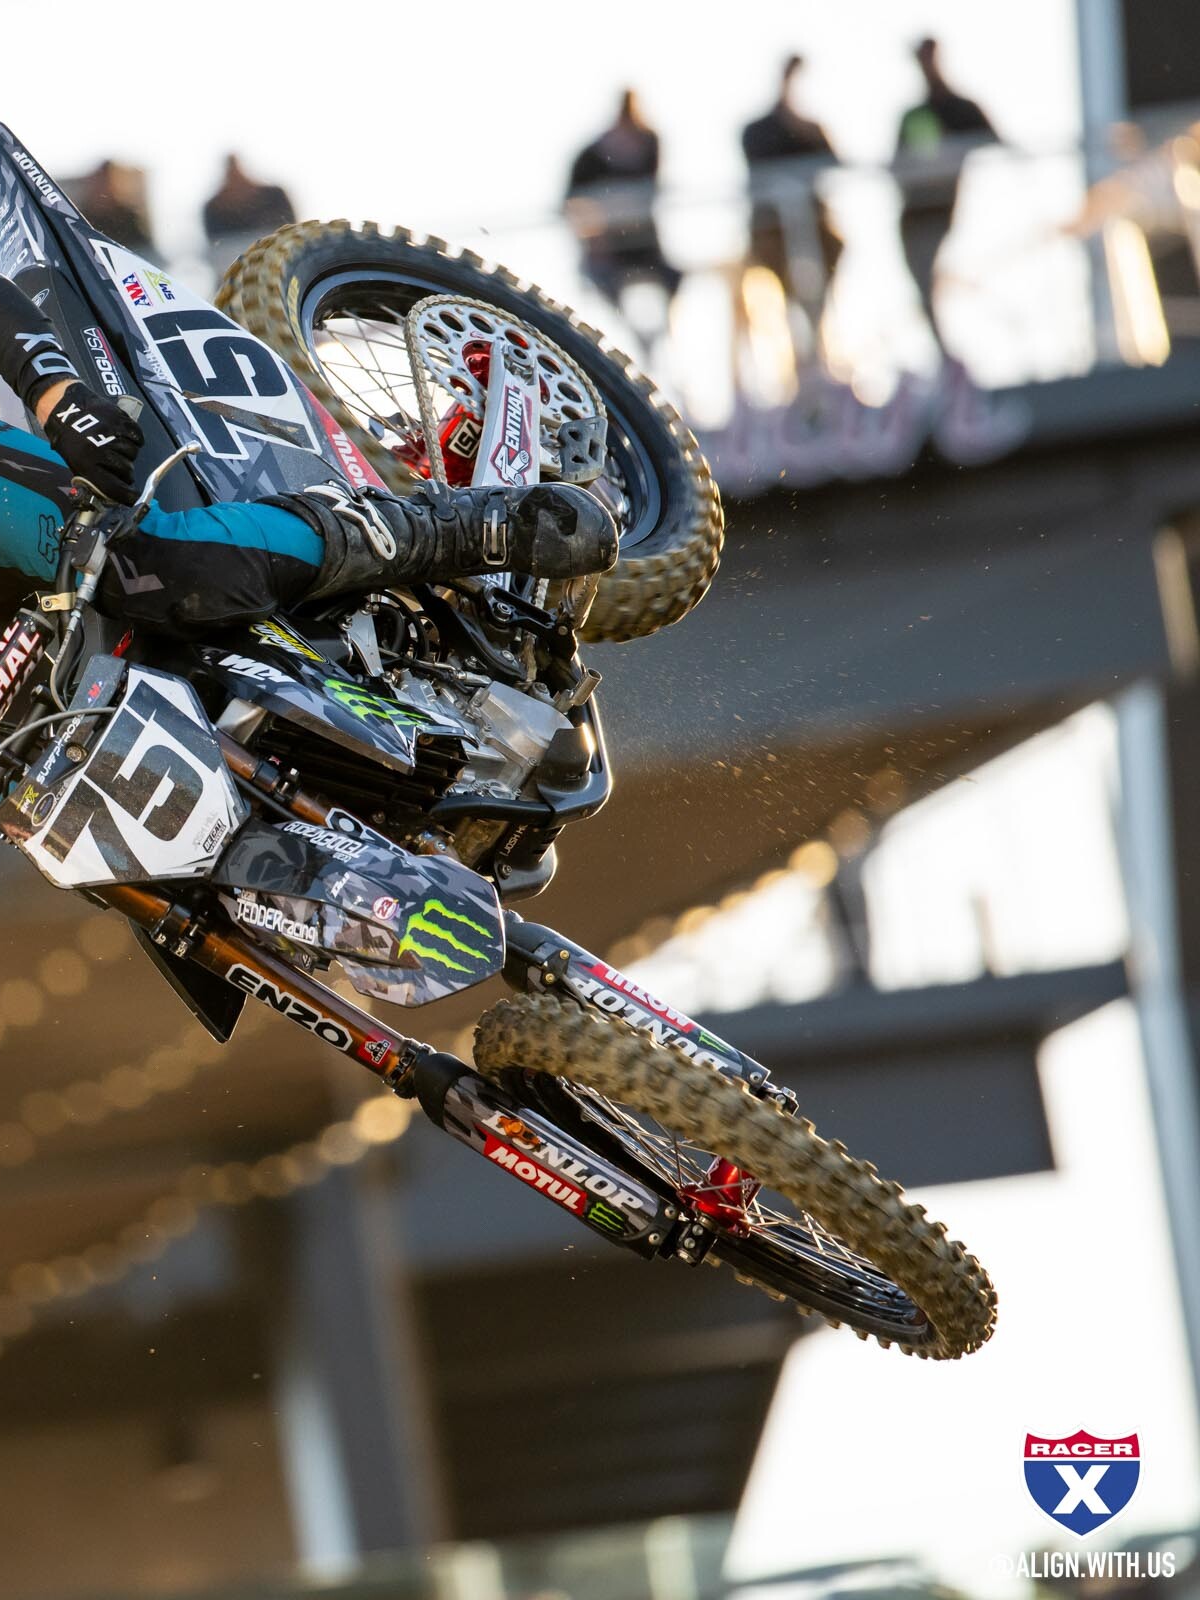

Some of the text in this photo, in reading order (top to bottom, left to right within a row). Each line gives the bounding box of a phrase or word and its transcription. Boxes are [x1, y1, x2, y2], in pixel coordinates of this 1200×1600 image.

[13, 151, 62, 204] DUNLOP
[122, 272, 151, 306] AMA
[15, 331, 79, 377] OX
[143, 309, 314, 459] 751
[57, 403, 116, 448] FOX
[218, 654, 297, 683] KTM
[41, 679, 220, 881] 751
[227, 964, 351, 1049] ENZO
[488, 1146, 580, 1210] MOTUL
